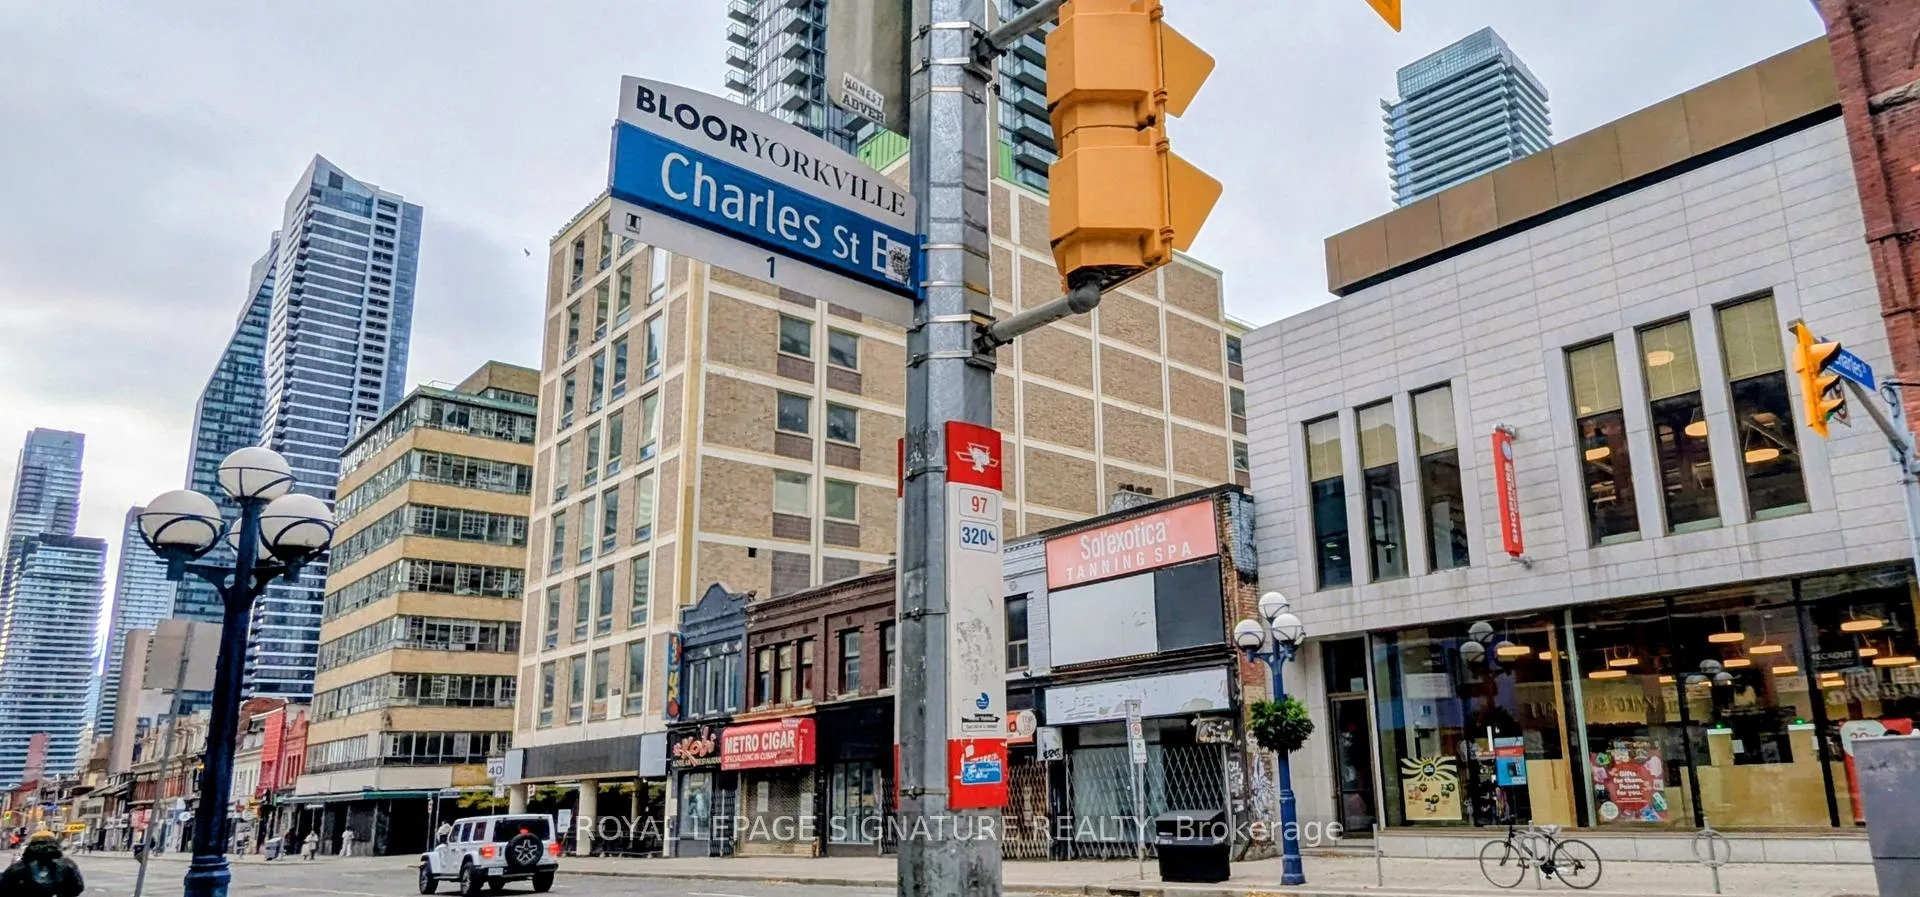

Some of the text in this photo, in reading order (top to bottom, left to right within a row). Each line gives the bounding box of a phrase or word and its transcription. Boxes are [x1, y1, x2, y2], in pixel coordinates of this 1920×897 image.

[661, 152, 822, 249] Charles
[832, 225, 860, 265] St
[766, 256, 776, 278] 1
[971, 495, 988, 514] 97
[1504, 462, 1519, 544] SHOPPERS
[962, 526, 988, 546] 320
[1066, 541, 1192, 582] TANNING SPA
[724, 734, 759, 753] METRO
[761, 730, 795, 751] CIGAR
[488, 766, 503, 776] 40
